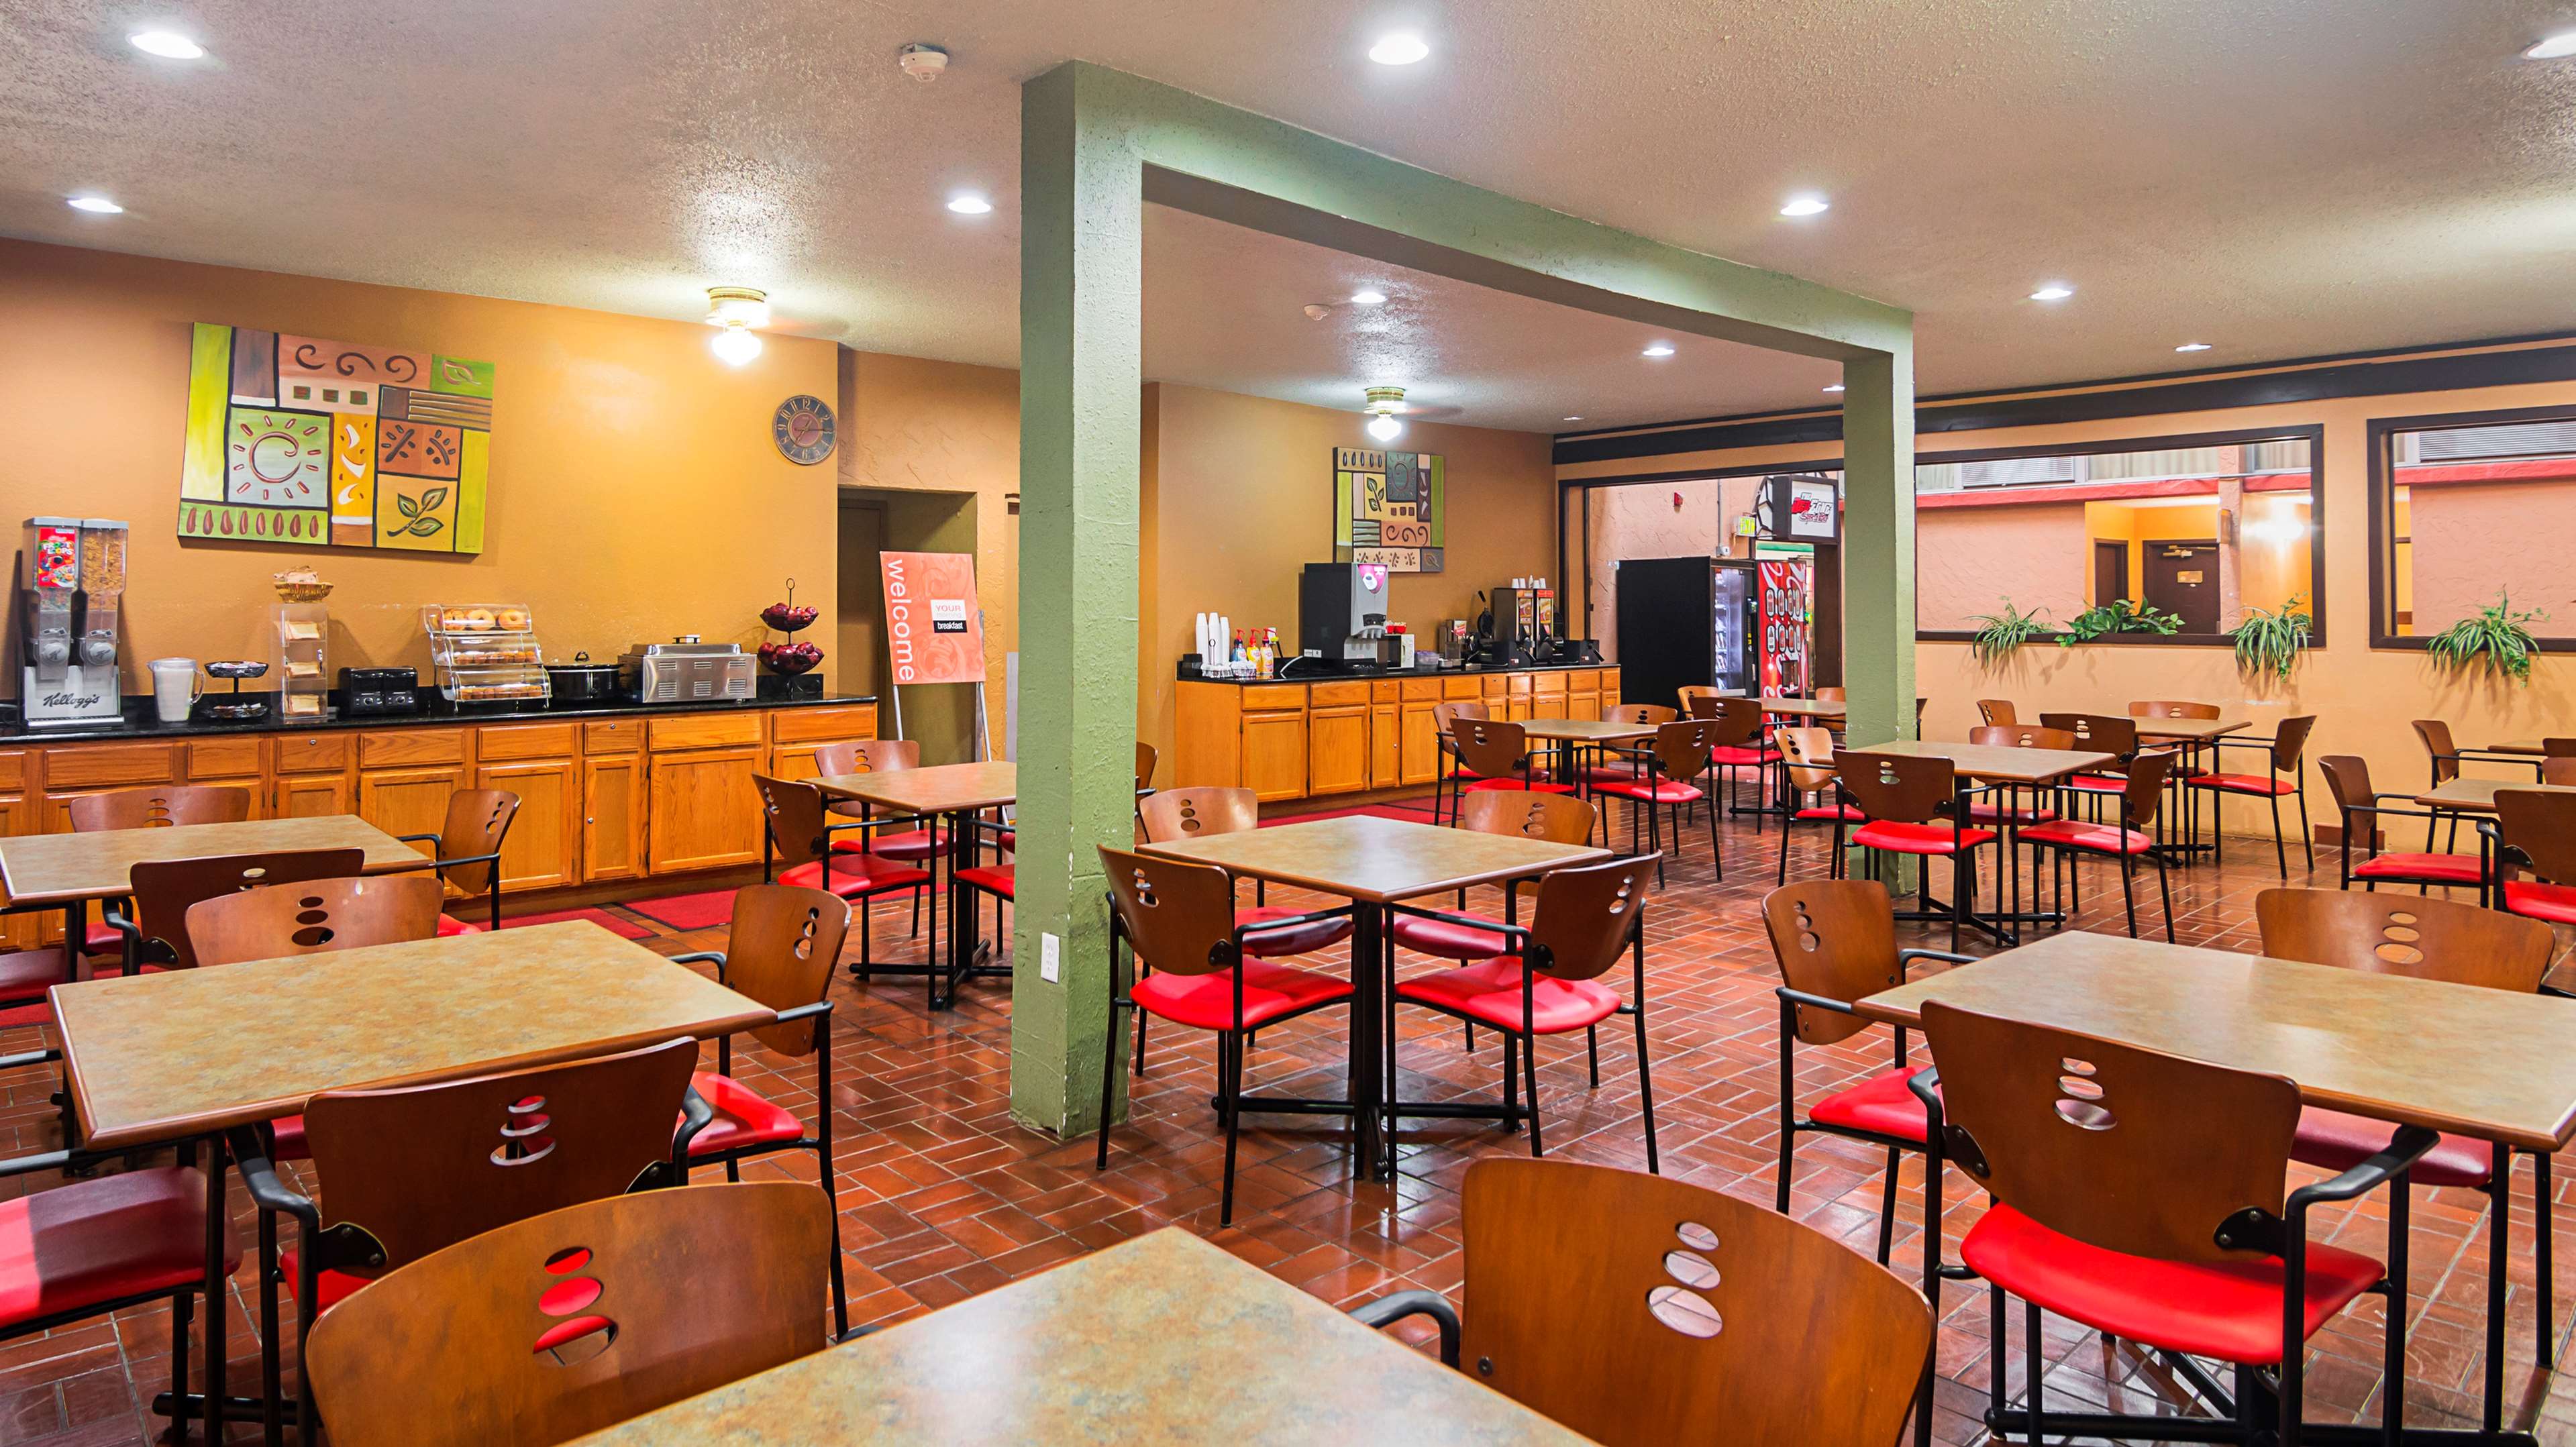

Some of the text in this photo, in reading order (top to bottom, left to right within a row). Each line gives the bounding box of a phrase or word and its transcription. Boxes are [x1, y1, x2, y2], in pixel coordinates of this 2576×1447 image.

[1740, 517, 1755, 535] EXIT
[48, 547, 72, 555] LOOPS
[887, 559, 915, 681] welcome
[43, 692, 100, 708] Kellogg's
